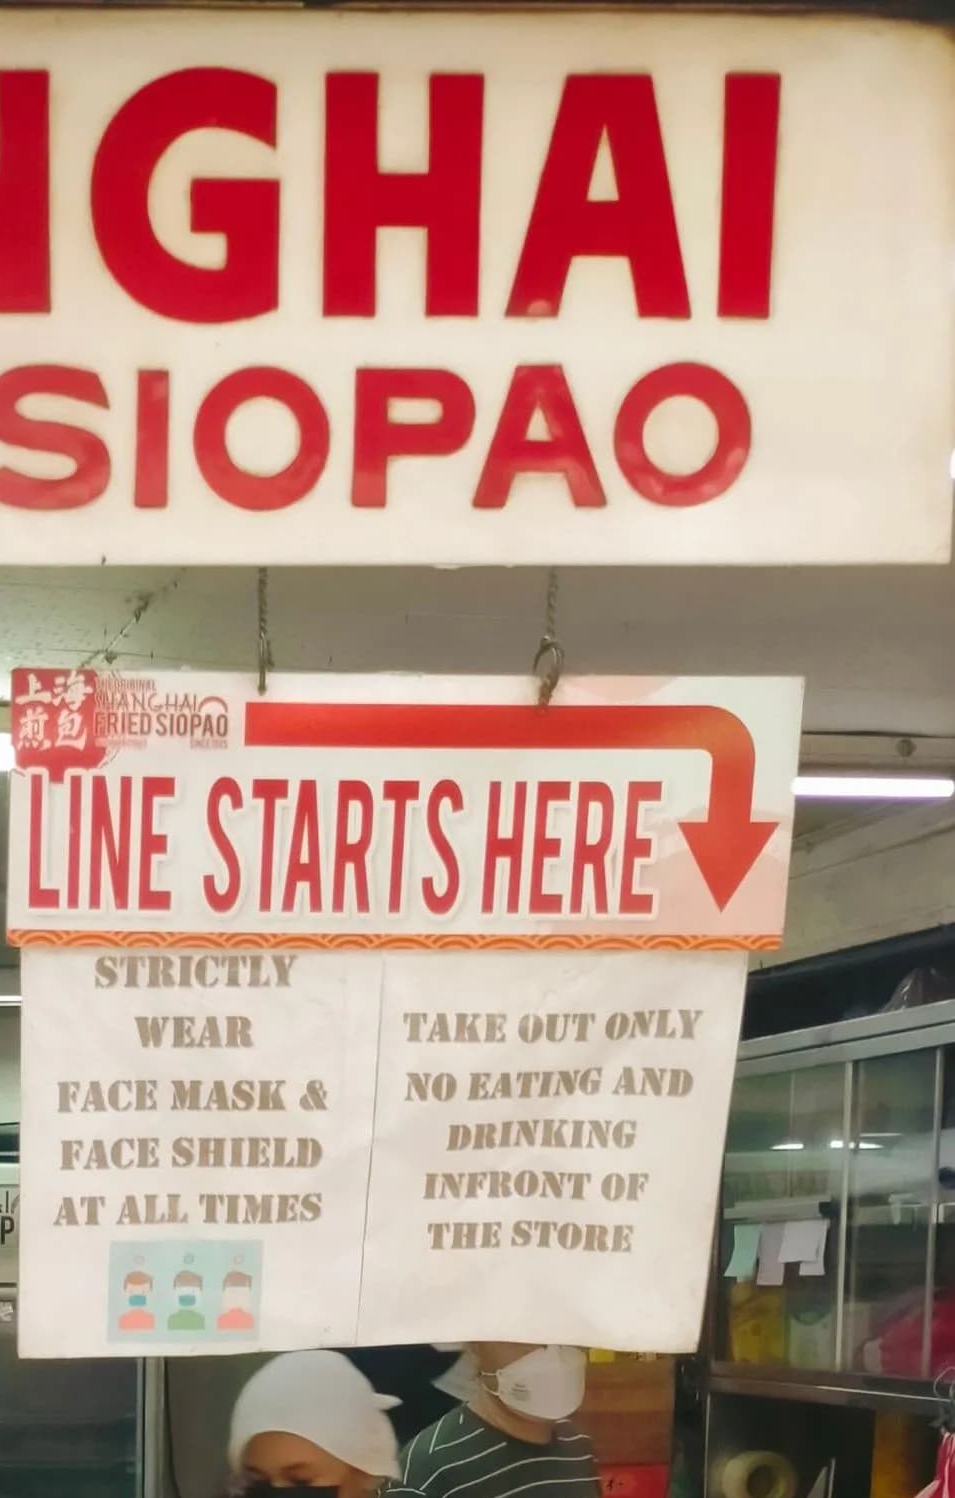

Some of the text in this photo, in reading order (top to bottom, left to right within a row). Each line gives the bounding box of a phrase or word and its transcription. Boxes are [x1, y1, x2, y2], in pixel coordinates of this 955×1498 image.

[96, 692, 197, 712] SHANGHAI
[95, 712, 228, 738] FRIED SIOPAO
[27, 773, 662, 915] LINE STARTS HERE
[94, 954, 298, 989] STRICTLY
[134, 1016, 254, 1048] WEAR
[403, 1009, 703, 1043] TAKE OUT ONLY
[57, 1079, 328, 1113] FACE MASK &
[405, 1067, 694, 1101] NO EATING AND
[446, 1118, 637, 1151] DRINKING
[60, 1136, 324, 1170] FACE SHIELD
[423, 1170, 649, 1201] INFRONT OF
[53, 1192, 322, 1226] AT ALL TIMES
[427, 1220, 634, 1253] THE STORE
